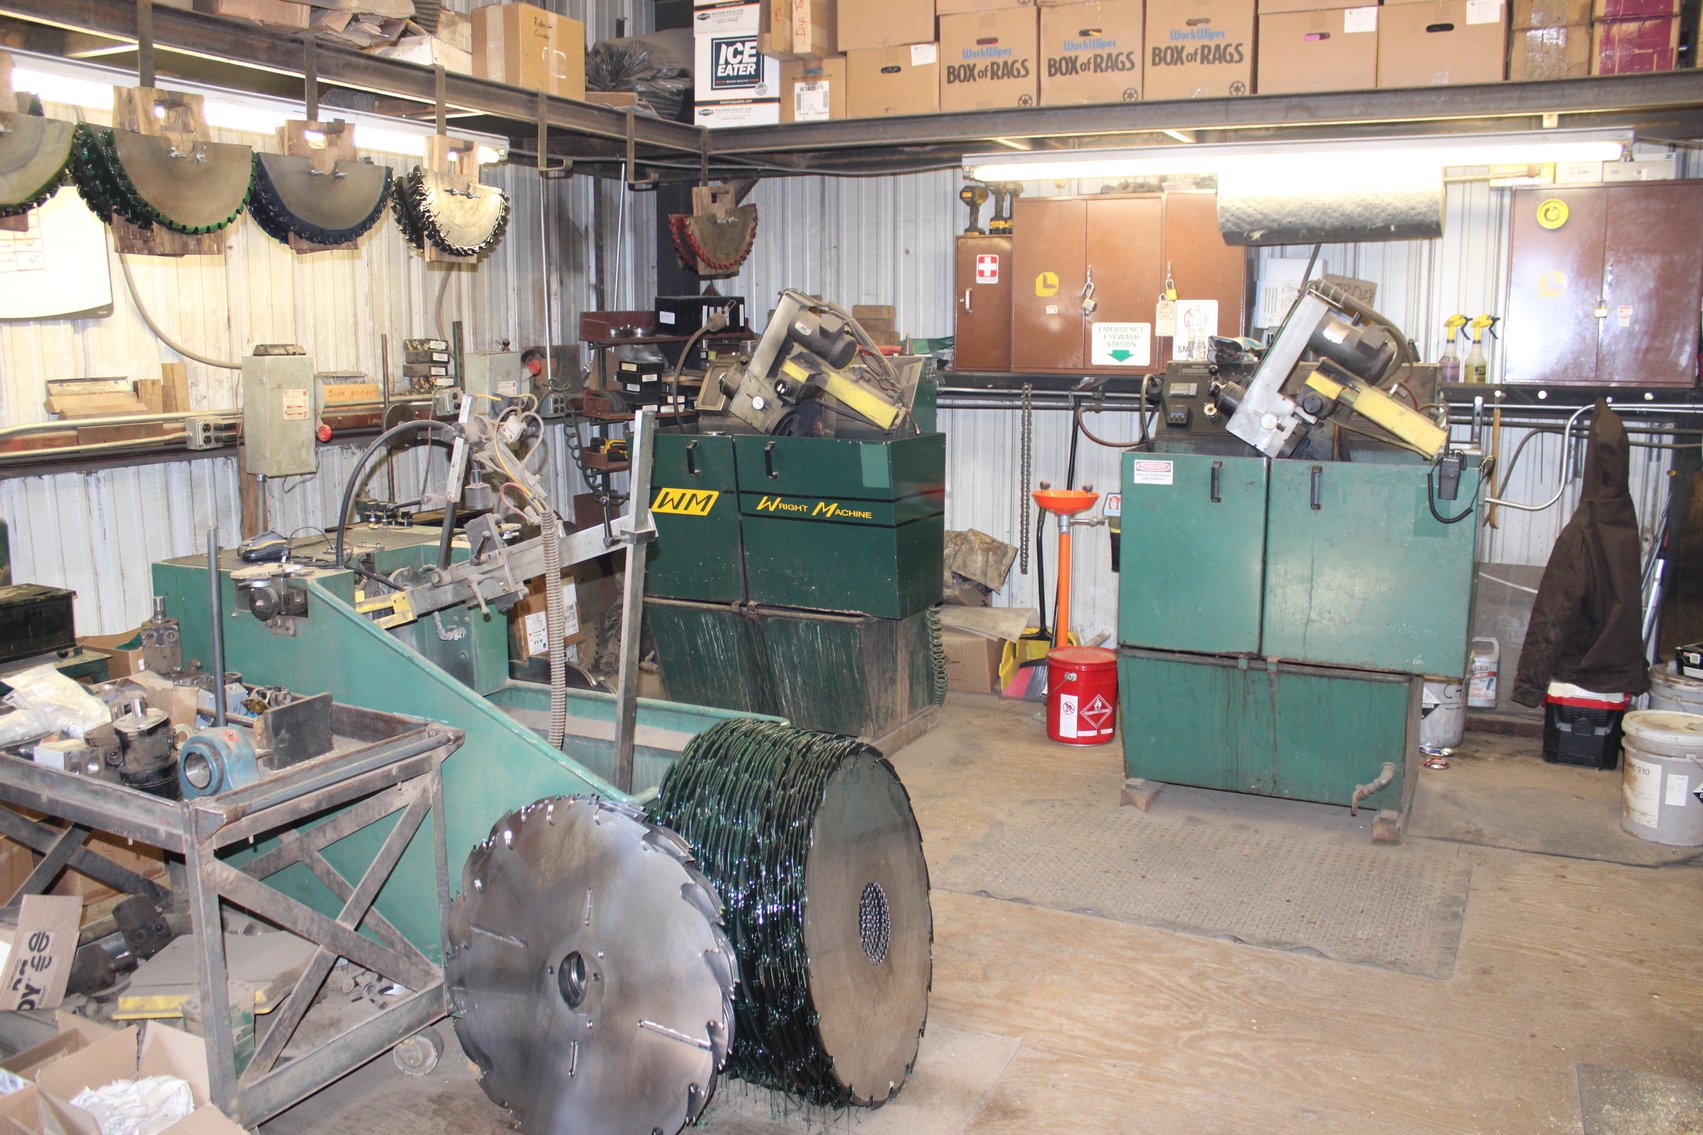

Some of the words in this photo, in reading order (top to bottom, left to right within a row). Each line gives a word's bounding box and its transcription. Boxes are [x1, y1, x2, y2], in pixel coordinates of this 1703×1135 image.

[1170, 28, 1225, 41] WorkWipes
[719, 41, 757, 65] ICE
[962, 47, 1011, 59] WorkWipes
[1064, 39, 1116, 51] WorkWipes
[1152, 45, 1185, 67] BOX
[1186, 48, 1199, 64] of
[1200, 43, 1244, 65] RAGS
[717, 63, 756, 77] EATER
[947, 63, 976, 84] BOX
[977, 65, 989, 79] of
[990, 58, 1029, 80] RAGS
[1047, 55, 1079, 78] BOX
[1080, 58, 1092, 73] of
[1093, 52, 1135, 74] RAGS
[657, 491, 713, 512] WM
[1637, 766, 1650, 776] 930
